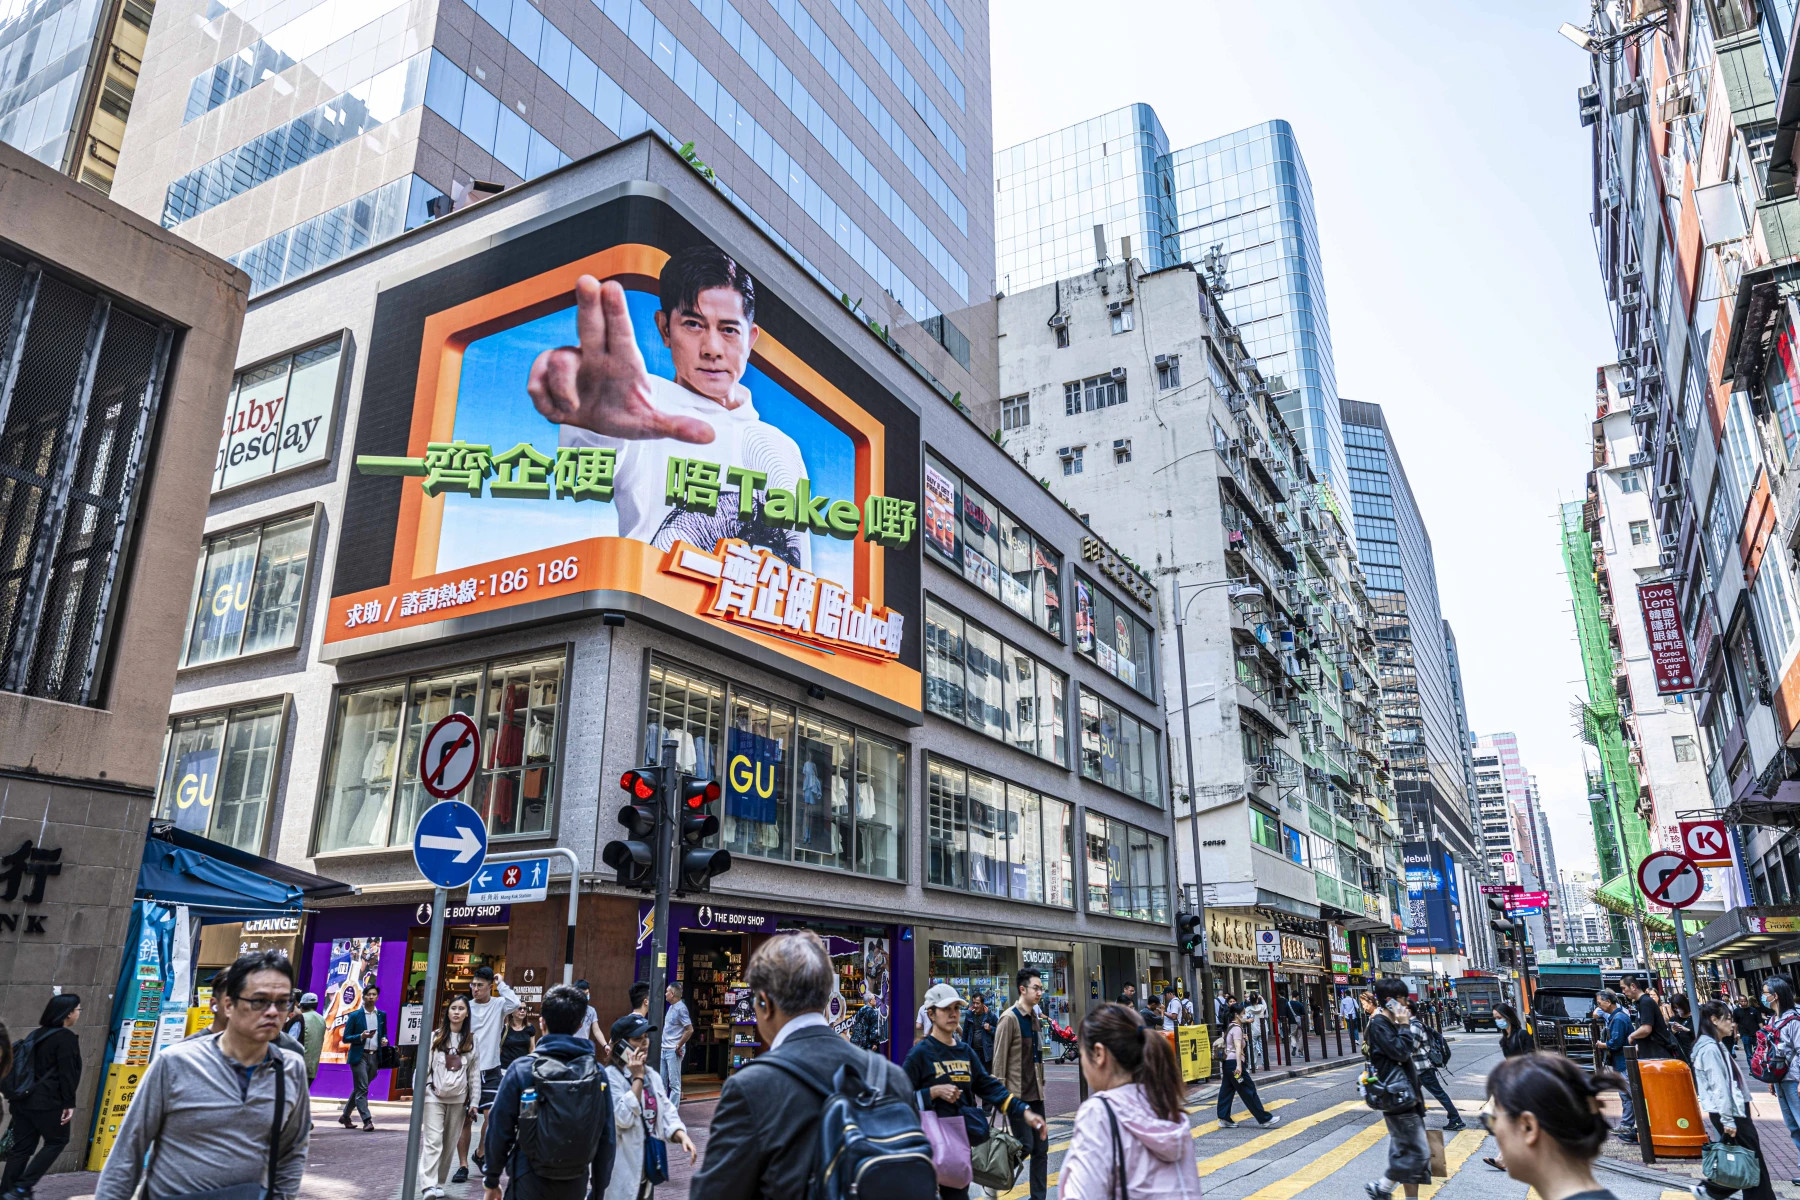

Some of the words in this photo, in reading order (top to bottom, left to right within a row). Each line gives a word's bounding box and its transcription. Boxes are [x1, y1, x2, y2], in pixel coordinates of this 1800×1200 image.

[221, 396, 284, 439] uby
[356, 440, 617, 503] 一齊企硬
[345, 598, 382, 628] 求助
[536, 556, 579, 586] 186
[1642, 588, 1673, 599] Love
[1643, 598, 1675, 609] Lens
[1656, 656, 1686, 665] Contact
[1667, 669, 1680, 677] 3/F
[729, 754, 775, 799] GU
[453, 907, 476, 918] BODY
[477, 905, 501, 916] SHOP
[245, 917, 298, 931] CHANGE
[714, 912, 728, 923] THE
[728, 914, 747, 924] BODY
[747, 915, 765, 926] SHOP
[454, 938, 470, 950] FACE
[943, 944, 962, 958] BOMB
[962, 946, 982, 960] CATCH
[1022, 950, 1038, 963] BOMB
[1037, 951, 1054, 964] CATCH
[407, 1018, 417, 1029] 75
[834, 1014, 857, 1034] BACK
